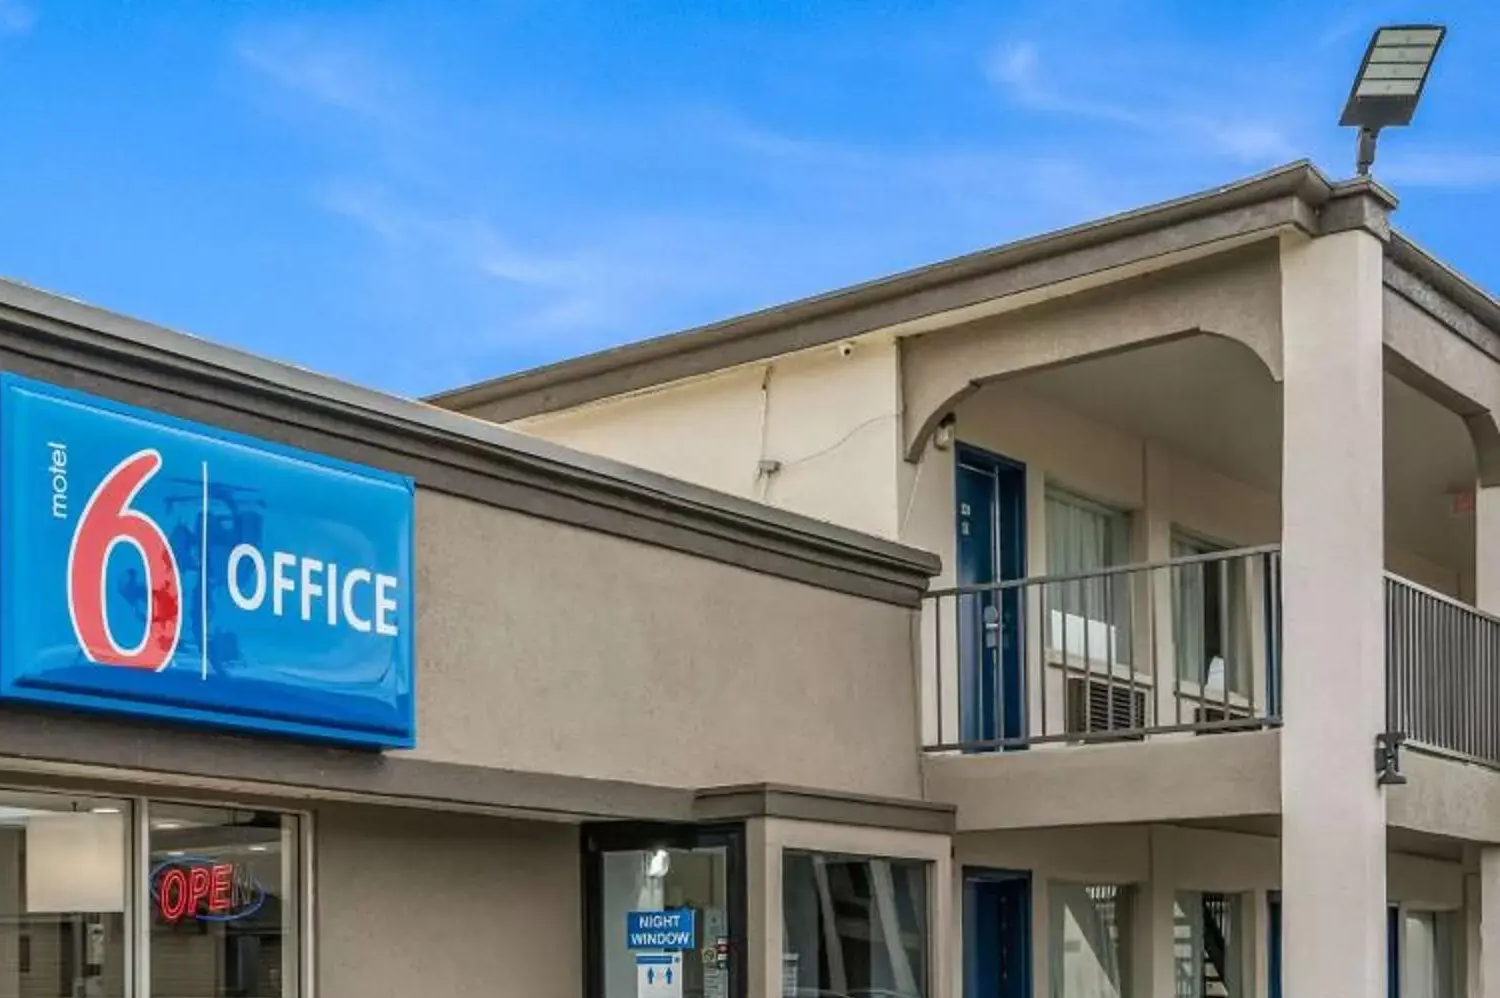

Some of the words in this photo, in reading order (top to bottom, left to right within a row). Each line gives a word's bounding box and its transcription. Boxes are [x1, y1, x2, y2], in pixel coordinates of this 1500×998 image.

[47, 441, 67, 519] motel
[67, 449, 183, 672] 6
[227, 543, 398, 637] OFFICE
[630, 932, 690, 945] WINDOW
[639, 915, 680, 928] NIGHT
